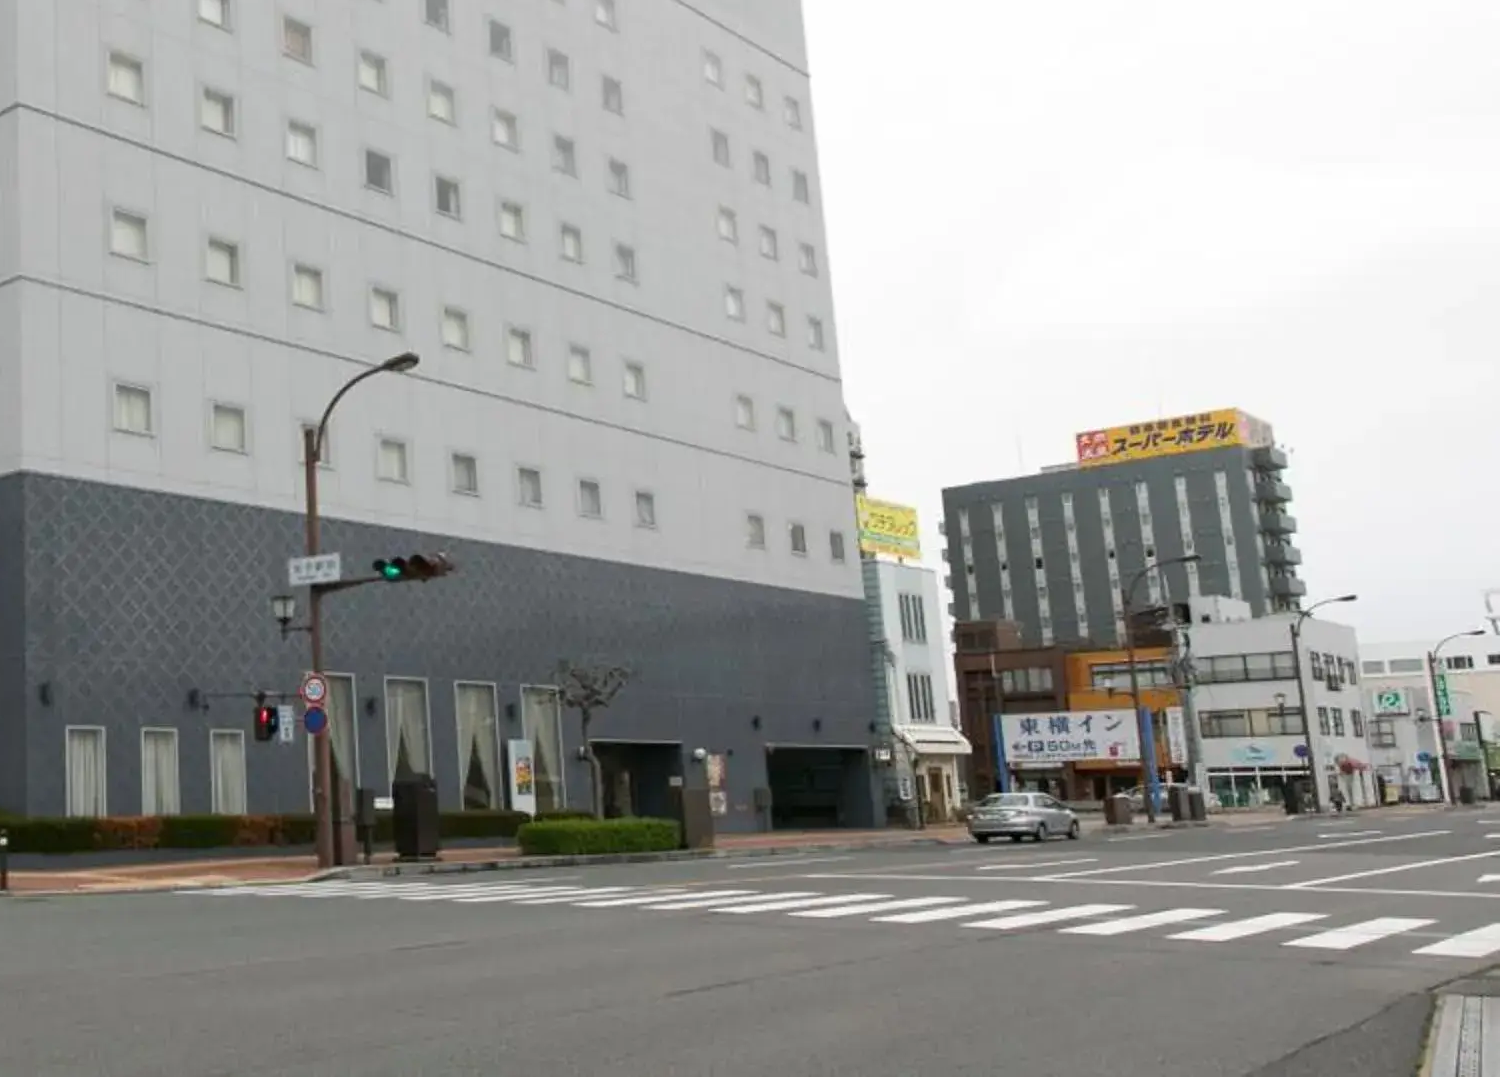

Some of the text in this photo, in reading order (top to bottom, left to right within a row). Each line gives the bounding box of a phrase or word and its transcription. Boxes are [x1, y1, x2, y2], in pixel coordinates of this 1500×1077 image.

[1111, 421, 1235, 455] スーパーホテル
[1020, 715, 1122, 735] 東横イン
